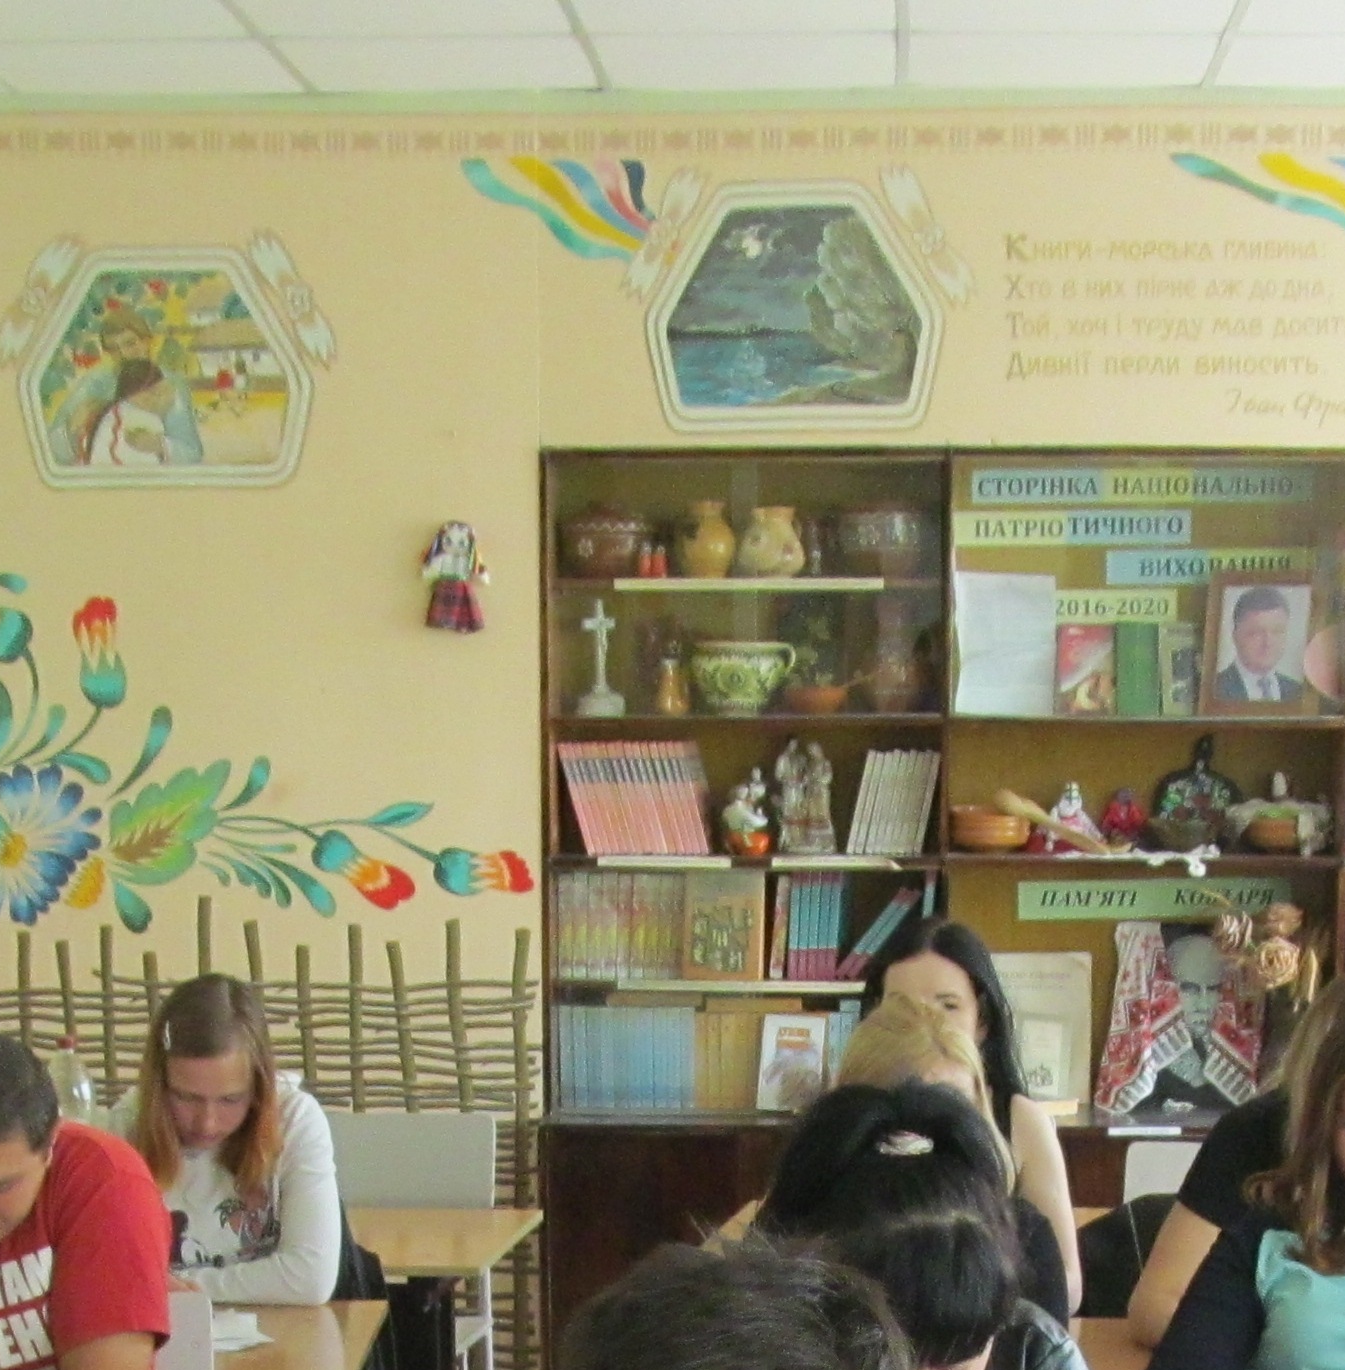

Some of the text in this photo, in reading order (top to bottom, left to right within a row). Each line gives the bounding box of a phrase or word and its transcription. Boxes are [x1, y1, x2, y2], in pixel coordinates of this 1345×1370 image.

[977, 476, 1099, 498] СТОРІНКА
[974, 515, 1184, 539] ПАТРІОТИЧНОГО
[1055, 598, 1170, 616] 2016-2020
